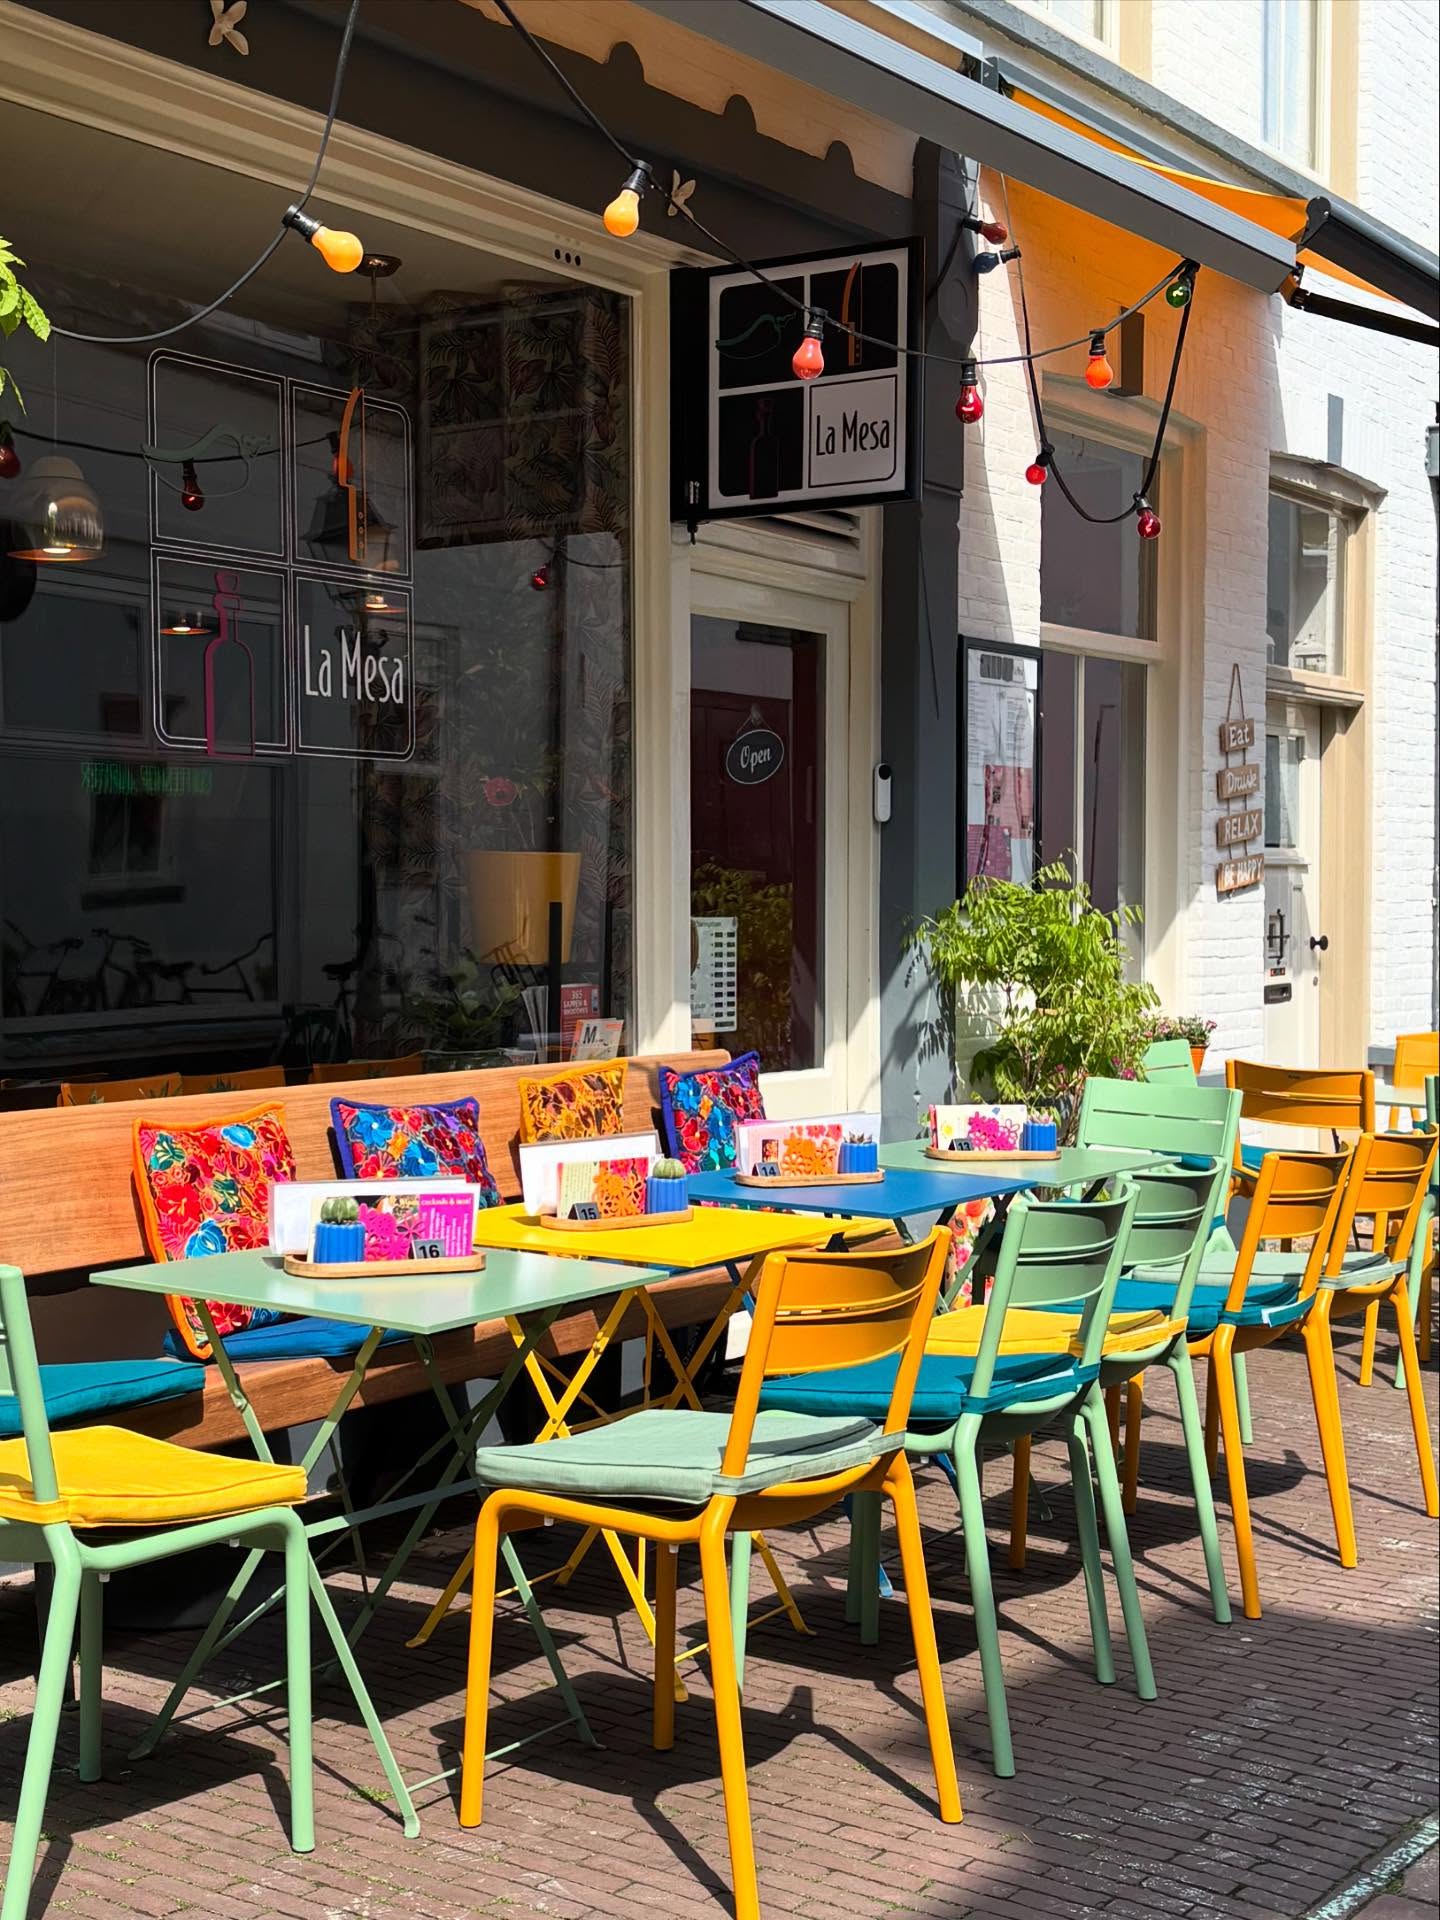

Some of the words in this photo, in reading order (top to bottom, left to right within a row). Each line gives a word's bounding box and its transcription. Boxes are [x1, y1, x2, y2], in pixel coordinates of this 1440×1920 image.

[816, 414, 836, 456] La
[842, 409, 890, 453] Mesa
[304, 624, 332, 697] La
[341, 628, 404, 705] Mesa
[1229, 723, 1250, 747] Eat
[740, 745, 771, 774] Open
[1226, 768, 1257, 795] Drink
[1224, 813, 1259, 845] RELAX
[1224, 863, 1236, 887] BE
[1237, 859, 1263, 884] HAPPY
[957, 1142, 970, 1151] 13
[761, 1166, 777, 1177] 14
[580, 1207, 597, 1220] 15
[419, 1244, 440, 1259] 16
